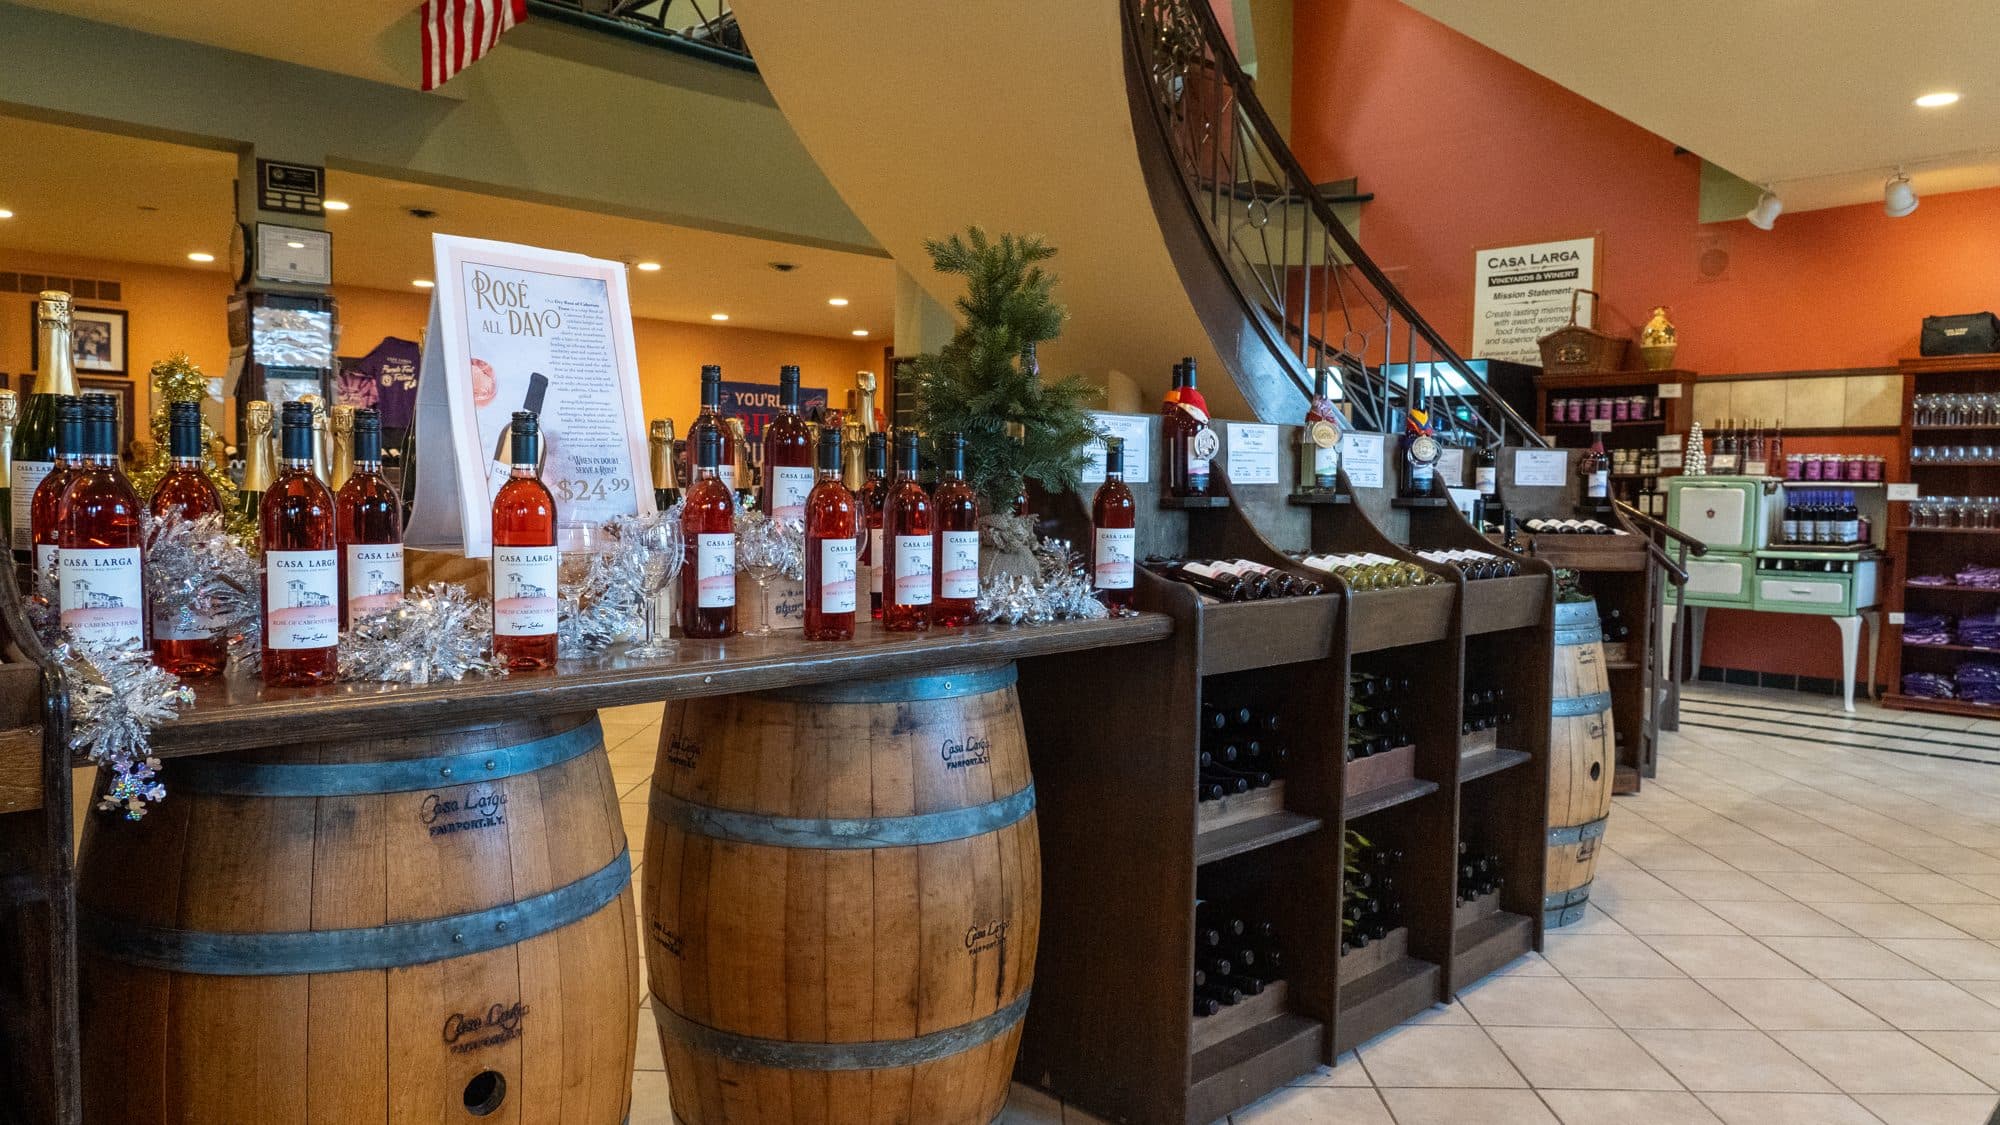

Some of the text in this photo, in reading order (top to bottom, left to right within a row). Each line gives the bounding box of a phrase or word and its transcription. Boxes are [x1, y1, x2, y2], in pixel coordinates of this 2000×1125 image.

[1487, 250, 1580, 269] CASA LARGA
[1490, 274, 1535, 285] VINEYARDS
[1493, 291, 1526, 300] Mission
[1485, 310, 1512, 319] Create
[482, 319, 504, 334] ALL
[508, 308, 561, 337] DAY
[1514, 325, 1544, 336] friendly
[1485, 337, 1501, 345] and
[495, 467, 508, 475] CAS
[557, 477, 630, 503] $24.99
[357, 552, 382, 560] CASA
[63, 557, 133, 567] CASA LARGA
[276, 560, 303, 568] CASA
[941, 738, 964, 761] Casa
[420, 794, 460, 825] Casa
[443, 1012, 482, 1043] Casa
